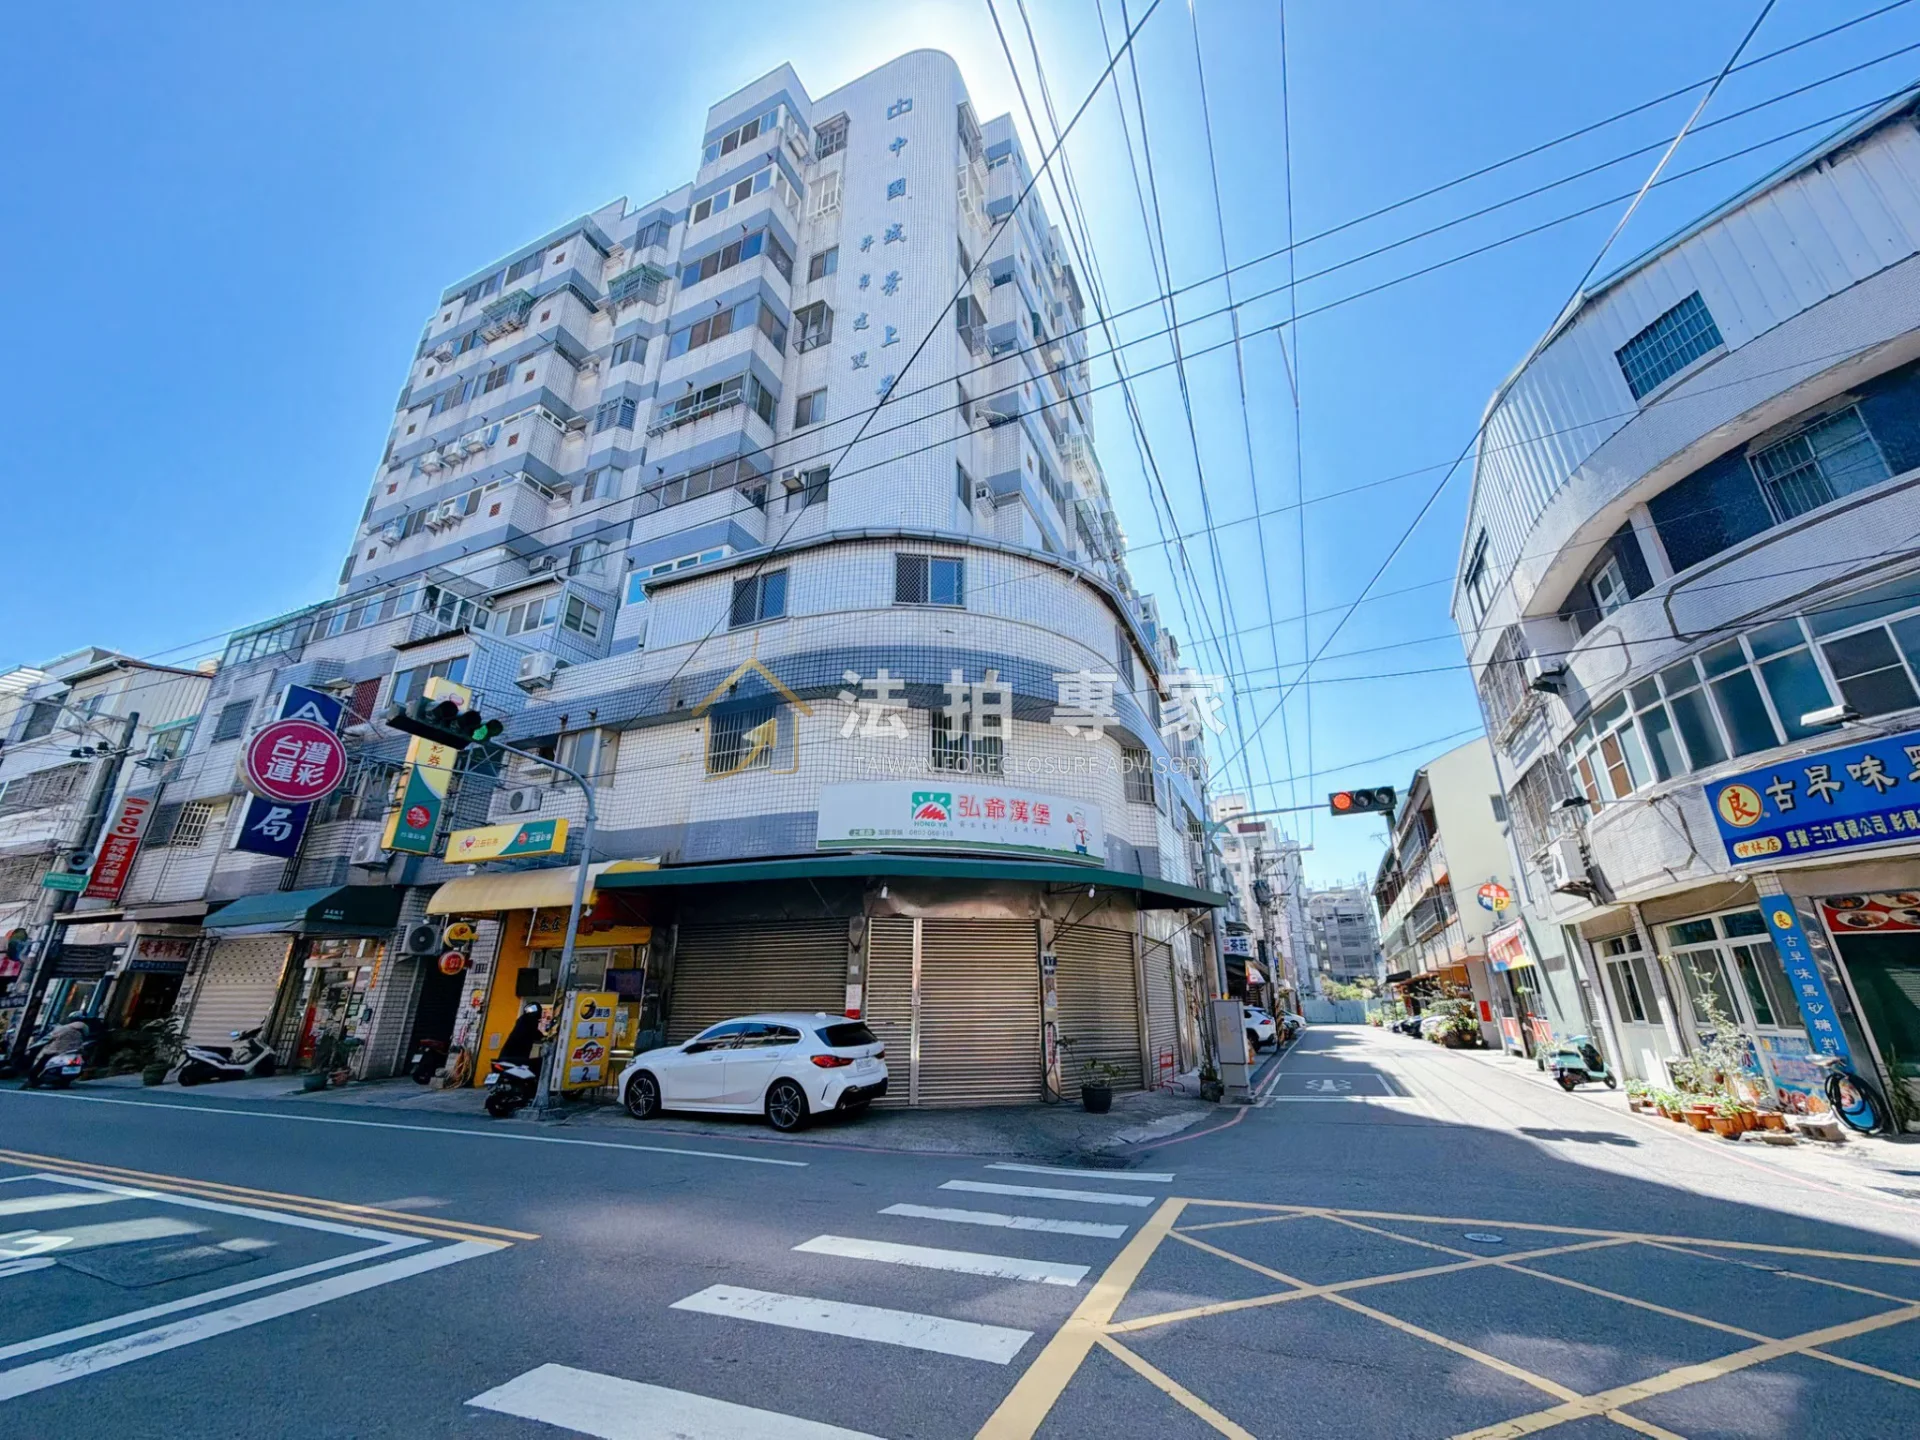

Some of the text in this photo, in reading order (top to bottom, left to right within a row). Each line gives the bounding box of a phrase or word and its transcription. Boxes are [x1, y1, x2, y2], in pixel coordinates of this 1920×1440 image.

[271, 735, 332, 765] 台灣
[262, 758, 326, 787] 運彩
[958, 794, 1052, 826] 弘爺漢堡
[1726, 788, 1757, 823] 良
[251, 805, 293, 842] 局
[1781, 934, 1841, 1056] 古早味黑砂糖剉
